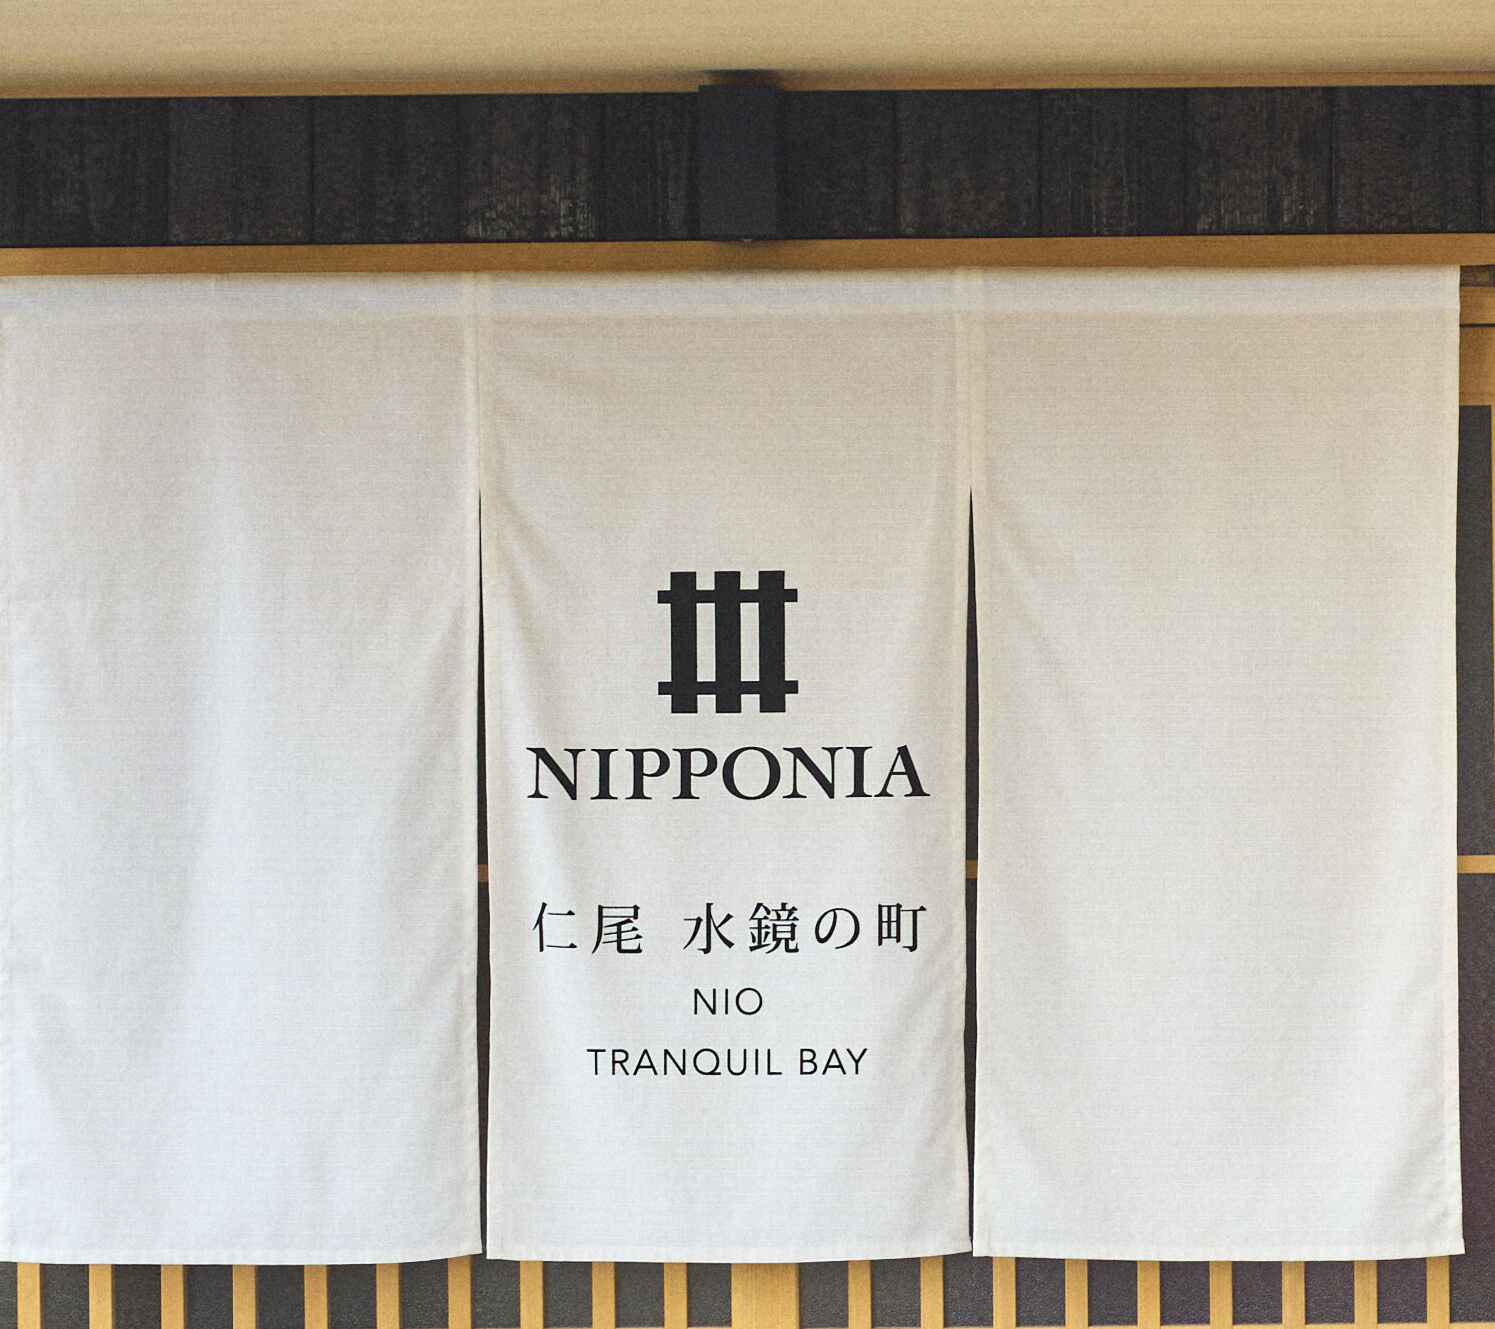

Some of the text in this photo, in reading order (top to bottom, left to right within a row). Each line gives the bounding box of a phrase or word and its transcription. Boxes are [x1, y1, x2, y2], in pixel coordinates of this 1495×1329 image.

[525, 743, 932, 802] NIPPONIA
[532, 901, 929, 956] 仁尾 水鏡の町
[692, 987, 764, 1016] NIO
[585, 1047, 869, 1077] TRANQUIL BAY
